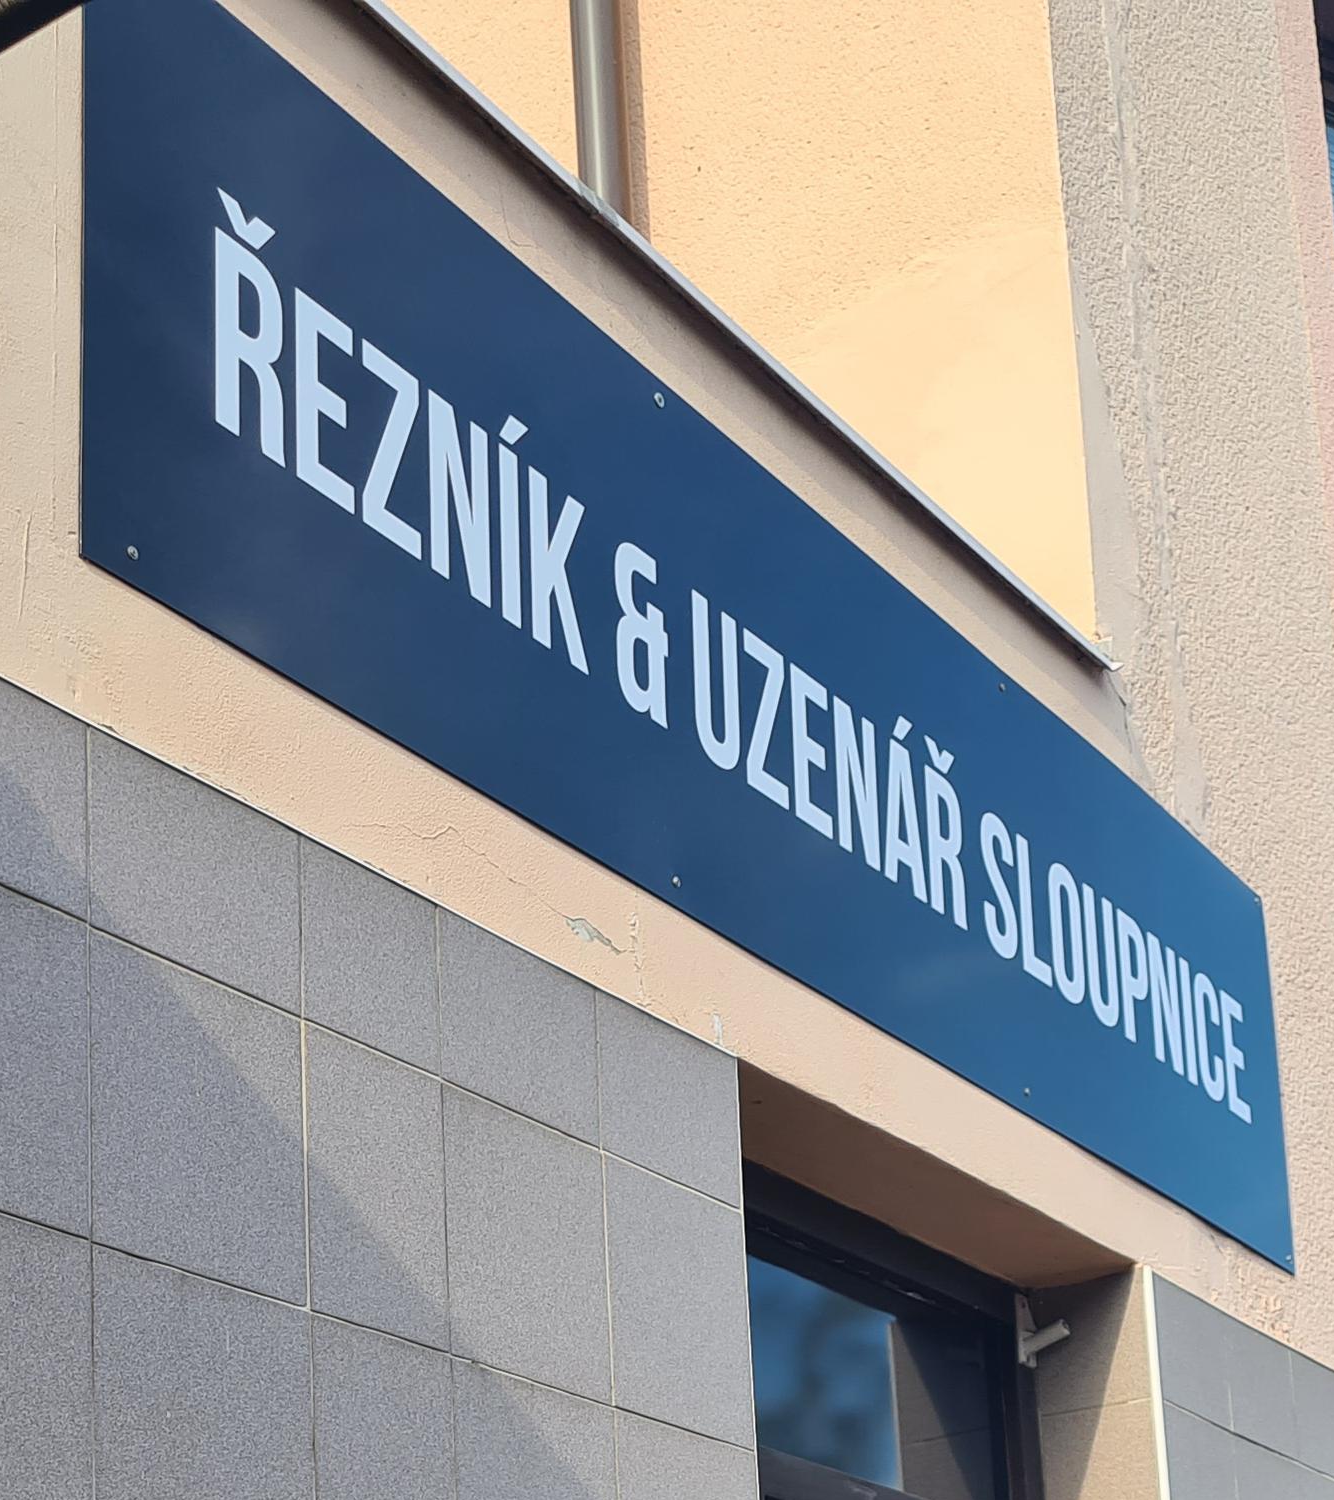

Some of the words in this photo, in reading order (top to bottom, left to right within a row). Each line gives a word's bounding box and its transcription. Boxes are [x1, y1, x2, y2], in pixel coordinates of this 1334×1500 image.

[214, 187, 589, 677] ŘEZNÍK
[613, 541, 670, 731] &
[691, 588, 968, 931] UZENÁŘ
[980, 812, 1253, 1126] SLOUPNICE
